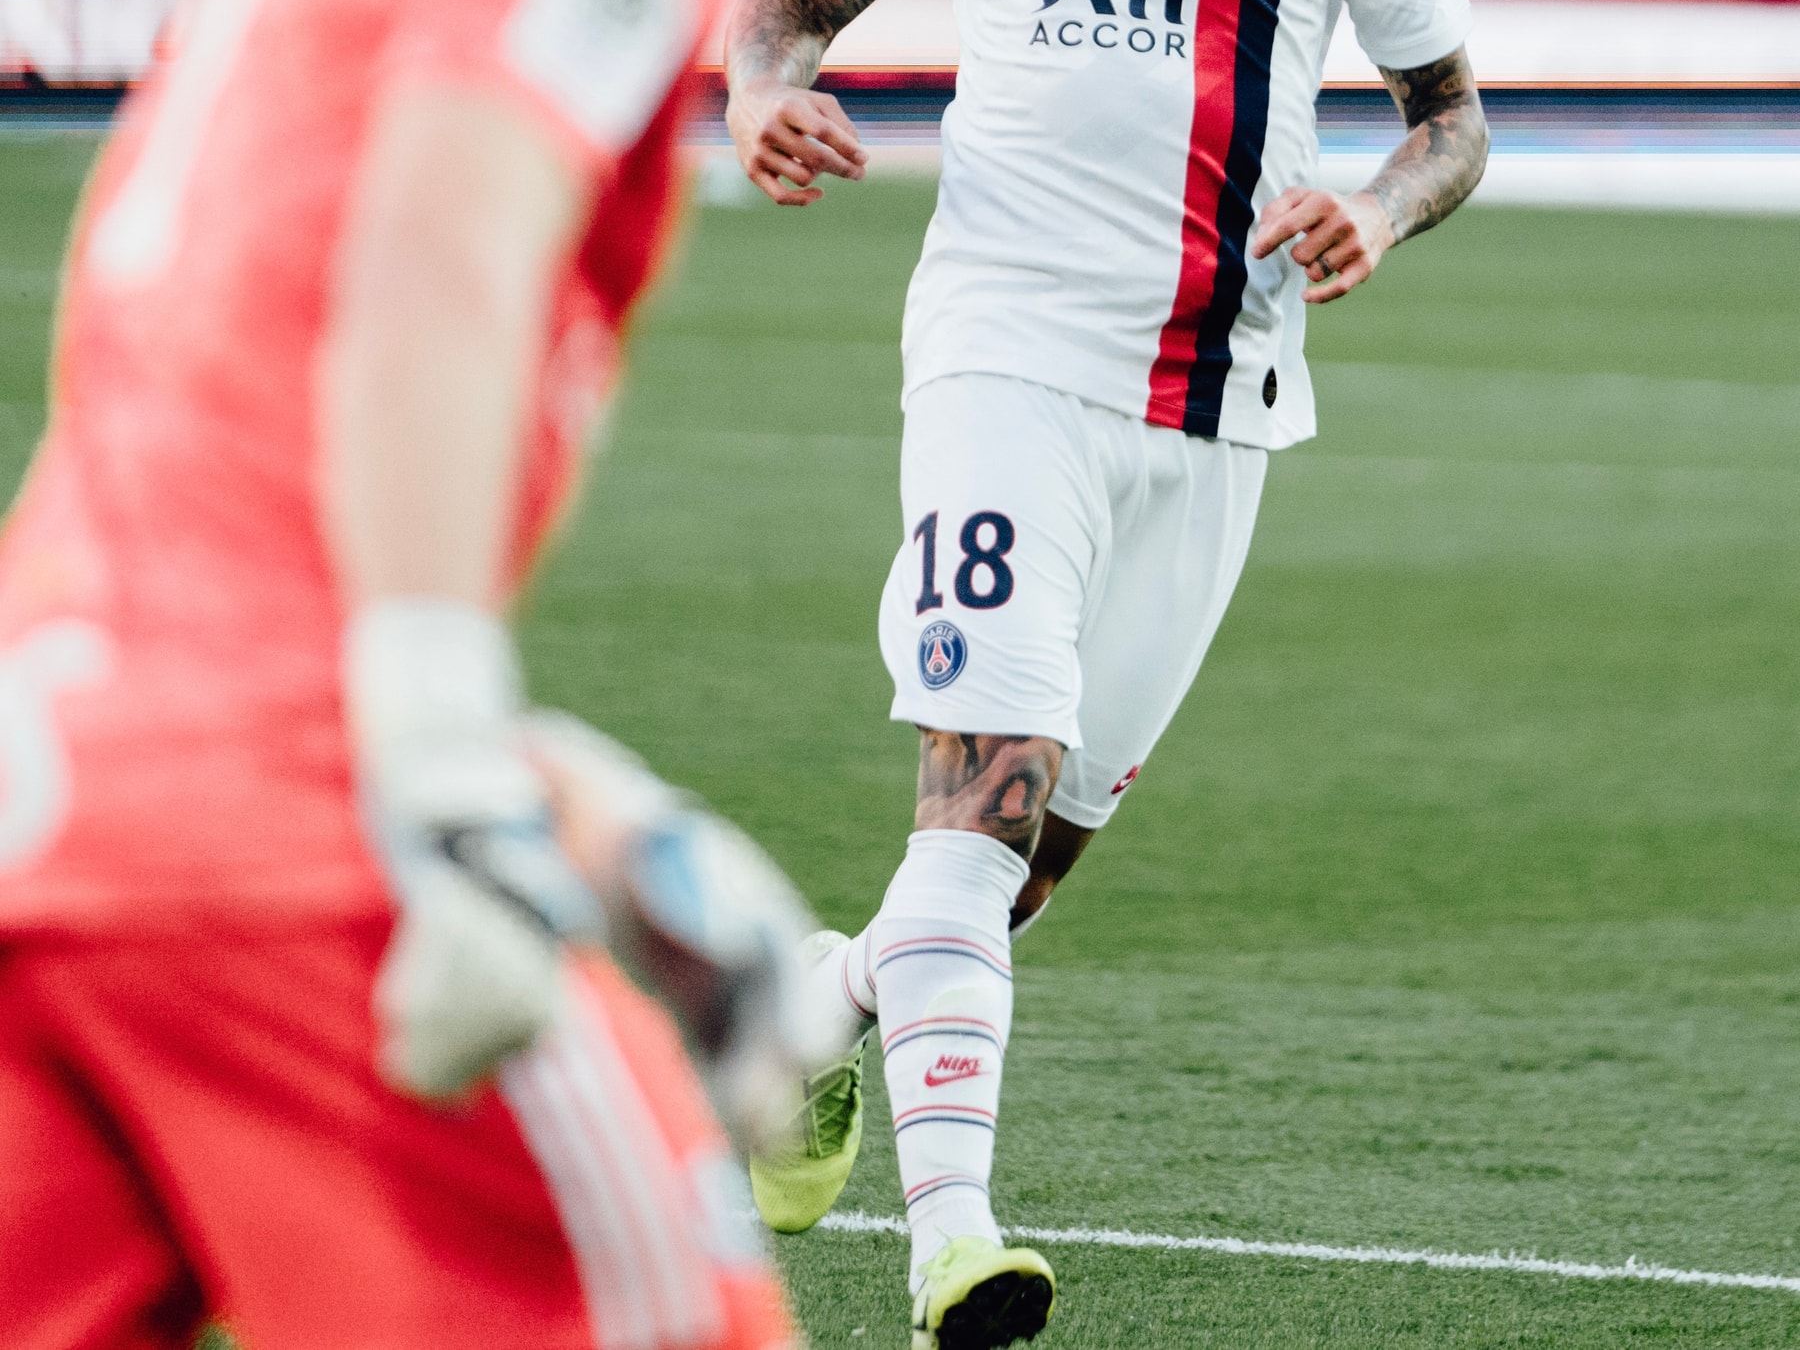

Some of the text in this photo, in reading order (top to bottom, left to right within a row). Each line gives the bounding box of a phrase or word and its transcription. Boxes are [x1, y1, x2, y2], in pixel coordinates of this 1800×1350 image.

[1029, 19, 1187, 58] ACCOR
[913, 509, 1015, 617] 18
[923, 626, 956, 644] PARIS
[935, 1054, 984, 1072] NIKE
